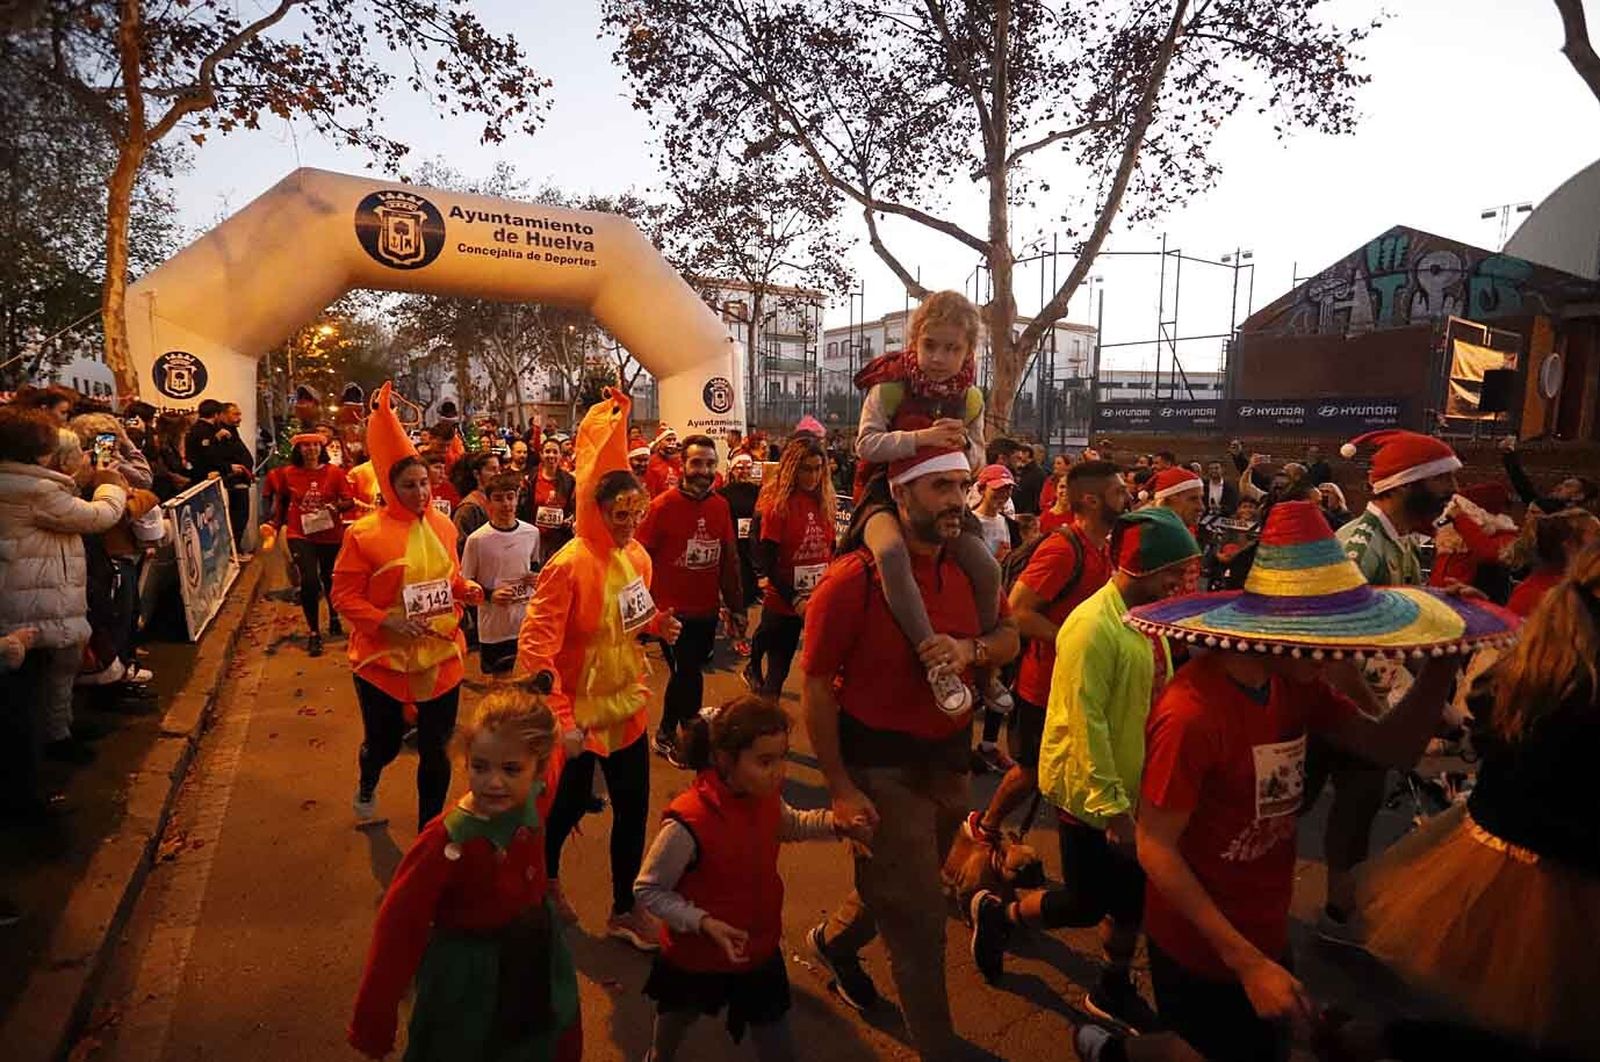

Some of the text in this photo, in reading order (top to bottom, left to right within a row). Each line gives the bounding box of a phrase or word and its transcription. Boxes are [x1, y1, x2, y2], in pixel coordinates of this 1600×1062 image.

[449, 205, 594, 235] Ayuntamiento
[493, 228, 595, 253] de Huelva
[526, 250, 541, 261] de
[544, 253, 597, 267] Deportes
[1115, 408, 1151, 417] HYUNDAI
[1175, 408, 1217, 417] HYUNDAI
[1256, 406, 1305, 417] HYUNDAI
[1340, 406, 1398, 416] HYUNDAI
[426, 590, 449, 607] 142
